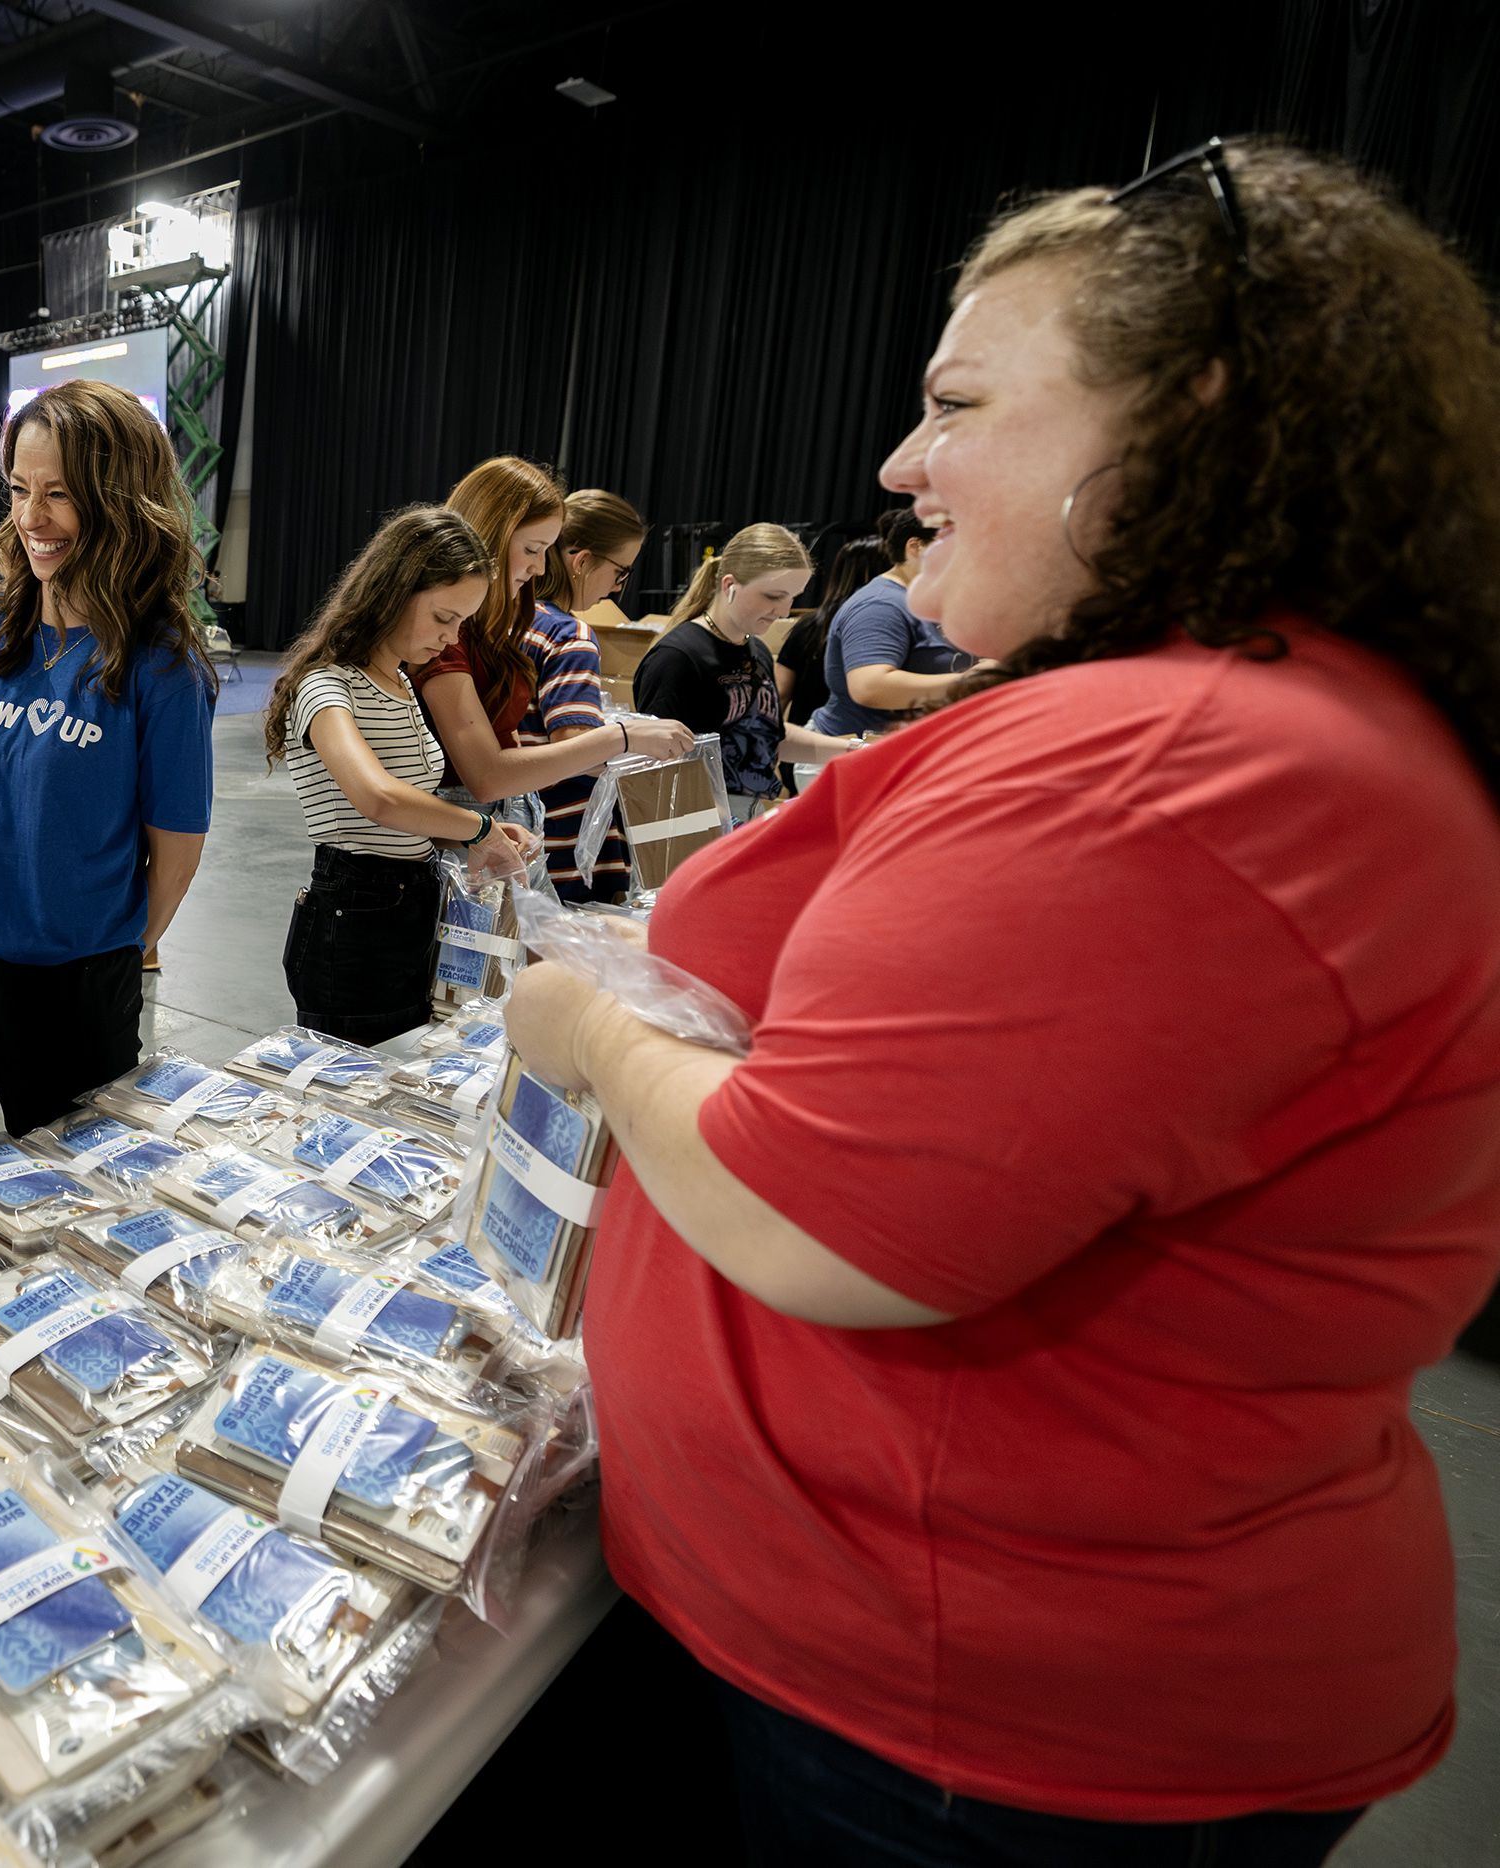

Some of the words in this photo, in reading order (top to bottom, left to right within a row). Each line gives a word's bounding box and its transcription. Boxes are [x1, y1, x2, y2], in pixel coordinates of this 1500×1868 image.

[59, 715, 103, 749] UP
[438, 969, 479, 986] TEACHERS
[439, 963, 456, 972] SHOW
[299, 1120, 346, 1156] TEHERS
[324, 1137, 336, 1147] UP
[502, 1128, 516, 1145] SHOW
[517, 1142, 525, 1153] UP
[501, 1139, 531, 1172] TEACHERS
[115, 1211, 173, 1235] EACHERS
[146, 1223, 158, 1233] UP
[489, 1202, 511, 1232] SHOW
[511, 1223, 522, 1240] UP
[485, 1214, 539, 1274] TEACHERS
[426, 1244, 468, 1271] CHERS
[460, 1255, 475, 1265] UP
[275, 1260, 316, 1301] TEACHER
[306, 1265, 328, 1287] SHOW
[3, 1276, 73, 1319] TACHERS
[300, 1284, 314, 1297] UP
[348, 1288, 379, 1317] TEACHERS
[374, 1289, 390, 1305] SHOW
[40, 1299, 53, 1311] UP
[367, 1303, 377, 1312] UP
[38, 1311, 85, 1338] TEACHERS
[58, 1326, 69, 1336] UP
[69, 1315, 94, 1329] SHOW
[265, 1367, 295, 1397] SHOW
[222, 1361, 284, 1430] TEACHERS
[257, 1395, 272, 1414] UP
[322, 1408, 358, 1457] TEACHERS
[349, 1412, 369, 1436] SHOW
[342, 1435, 353, 1448] UP
[121, 1479, 184, 1536] TEACHE
[162, 1487, 195, 1518] SHOW
[148, 1515, 166, 1533] UP
[195, 1524, 244, 1573] TEACHERS
[231, 1530, 254, 1554] SHOW
[219, 1551, 230, 1564] UP
[41, 1570, 75, 1592] SHOW
[25, 1587, 42, 1600] UP
